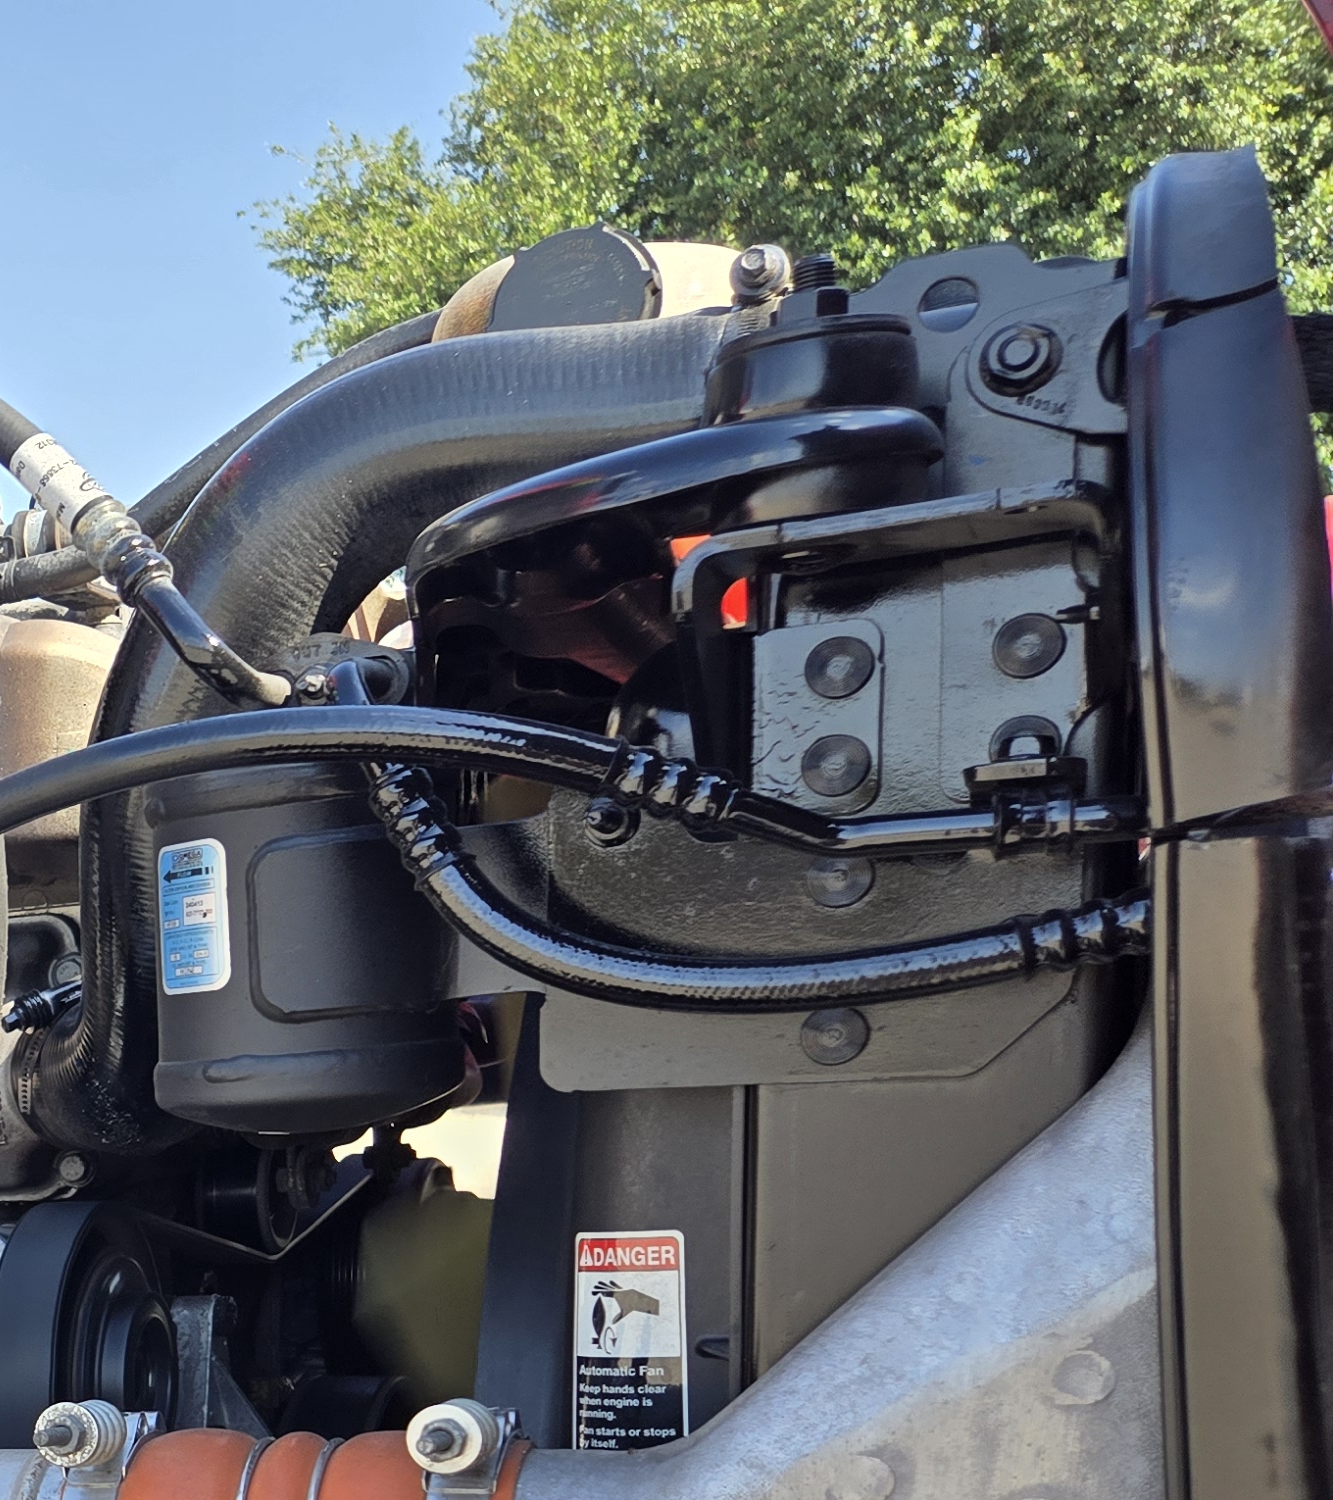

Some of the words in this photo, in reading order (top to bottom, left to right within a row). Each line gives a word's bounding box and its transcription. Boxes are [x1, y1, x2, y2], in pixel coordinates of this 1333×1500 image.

[592, 1245, 676, 1267] DANGER
[579, 1365, 636, 1377] Automatic
[639, 1365, 665, 1377] Fan
[579, 1383, 601, 1395] Keep
[602, 1384, 635, 1394] hands
[637, 1384, 667, 1394] clear
[579, 1396, 602, 1407] when
[603, 1397, 640, 1409] engine
[642, 1397, 653, 1407] is
[579, 1409, 617, 1421] running.
[579, 1425, 595, 1437] Fan
[596, 1426, 626, 1437] starts
[628, 1428, 641, 1437] or
[643, 1427, 676, 1439] stops
[579, 1438, 590, 1450] by
[590, 1437, 619, 1449] itself.
